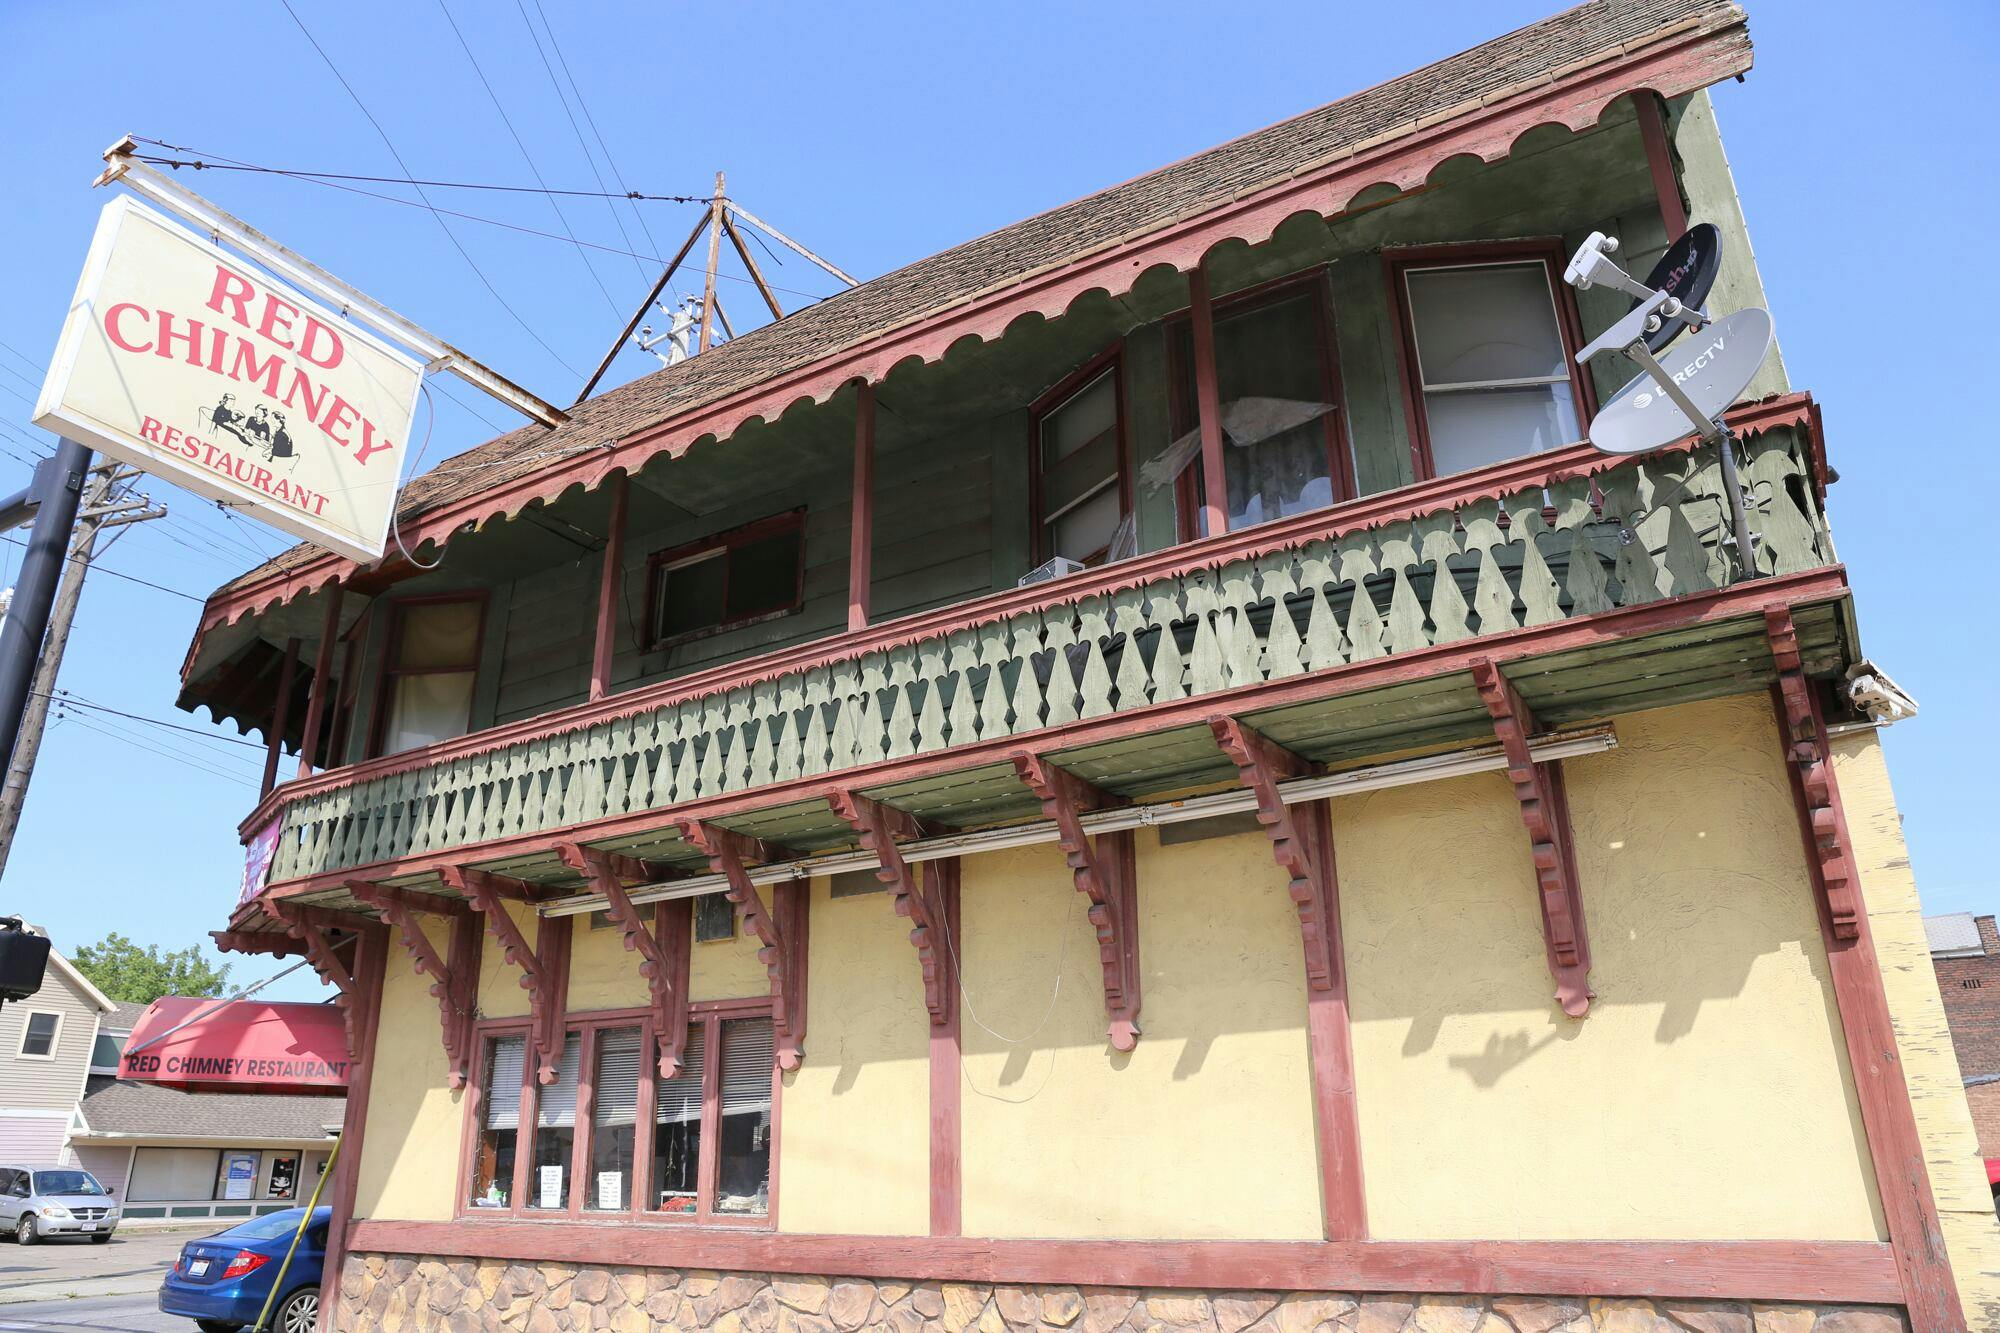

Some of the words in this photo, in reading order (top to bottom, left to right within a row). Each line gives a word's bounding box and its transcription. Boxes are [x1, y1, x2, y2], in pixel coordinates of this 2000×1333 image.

[205, 265, 344, 370] RED
[1655, 336, 1725, 397] DRECTV
[104, 302, 393, 466] CHIMNEY
[138, 415, 330, 517] RESTAURANT
[127, 1055, 161, 1073] RED
[166, 1056, 244, 1075] CHIMNEY
[246, 1059, 347, 1079] RESTAURANT
